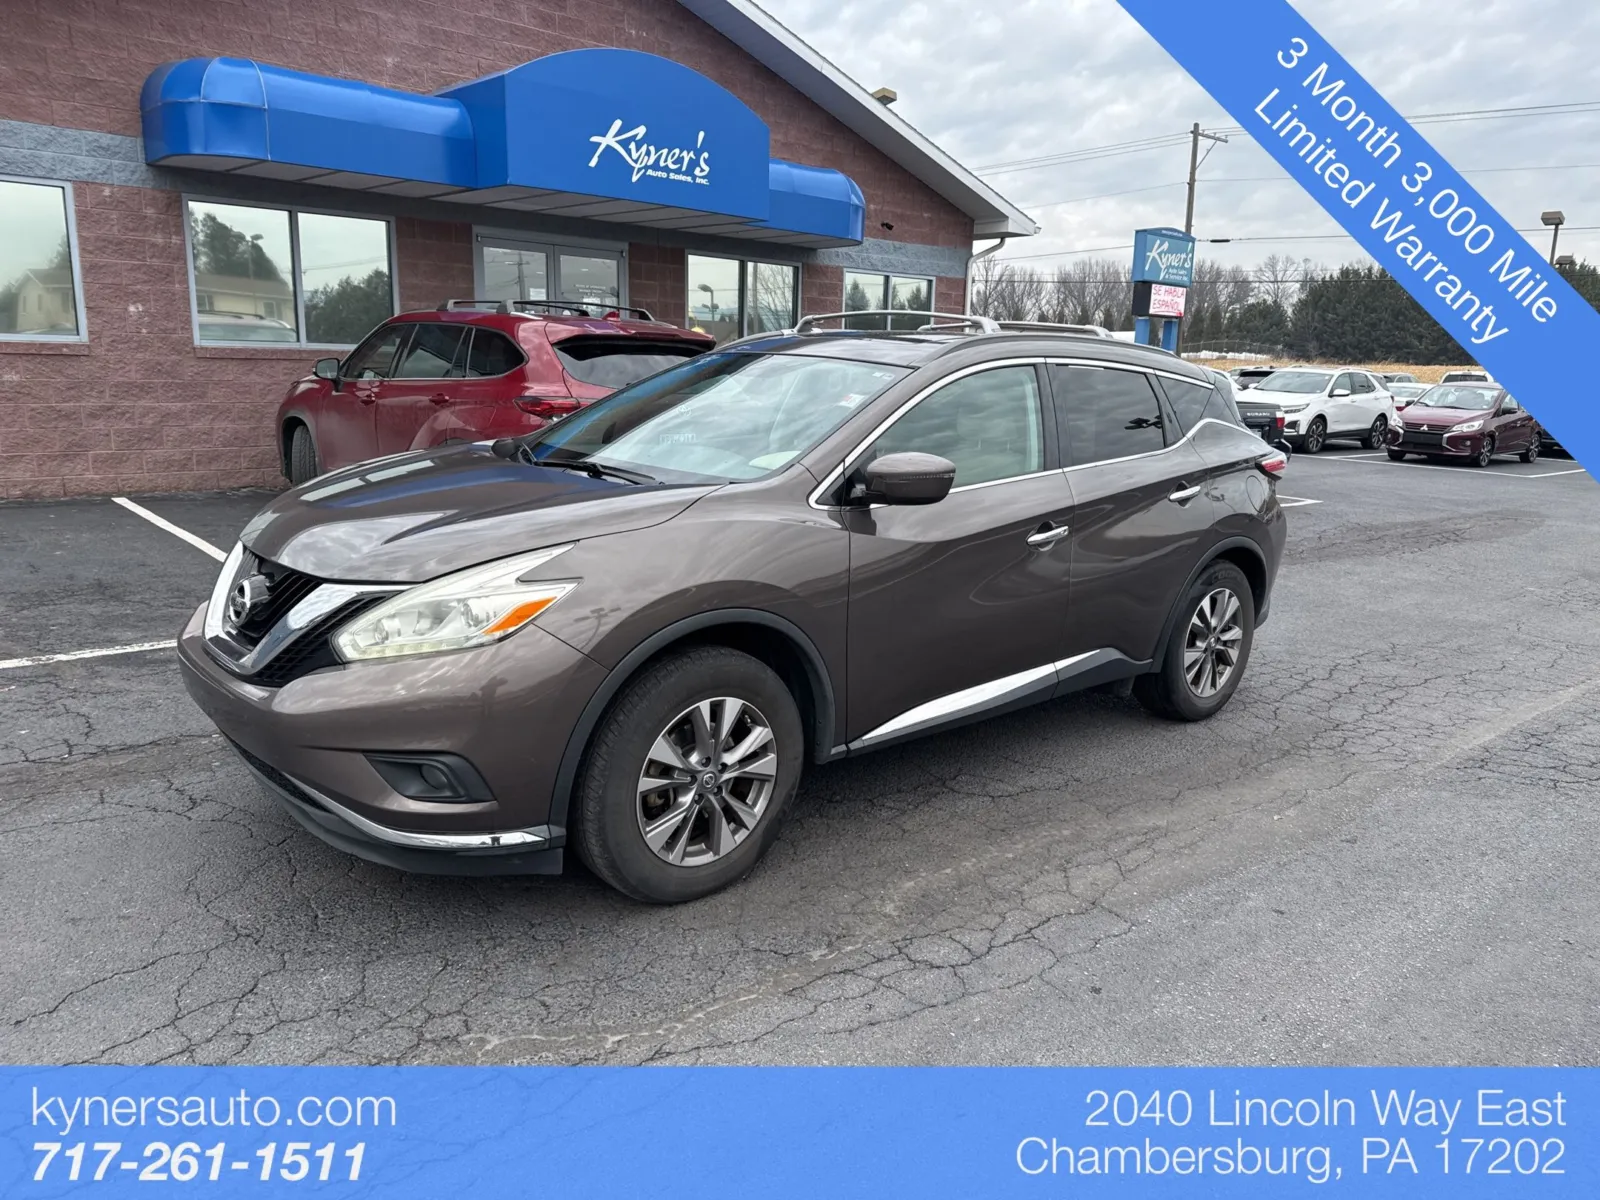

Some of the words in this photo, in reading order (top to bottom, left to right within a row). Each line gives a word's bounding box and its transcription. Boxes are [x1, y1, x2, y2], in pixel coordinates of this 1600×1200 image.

[588, 118, 710, 183] Kyner's
[646, 169, 668, 178] Auto
[668, 172, 693, 183] Sales,
[1145, 239, 1192, 280] Kyner's
[1153, 285, 1162, 296] SE
[1164, 287, 1184, 298] HABLA
